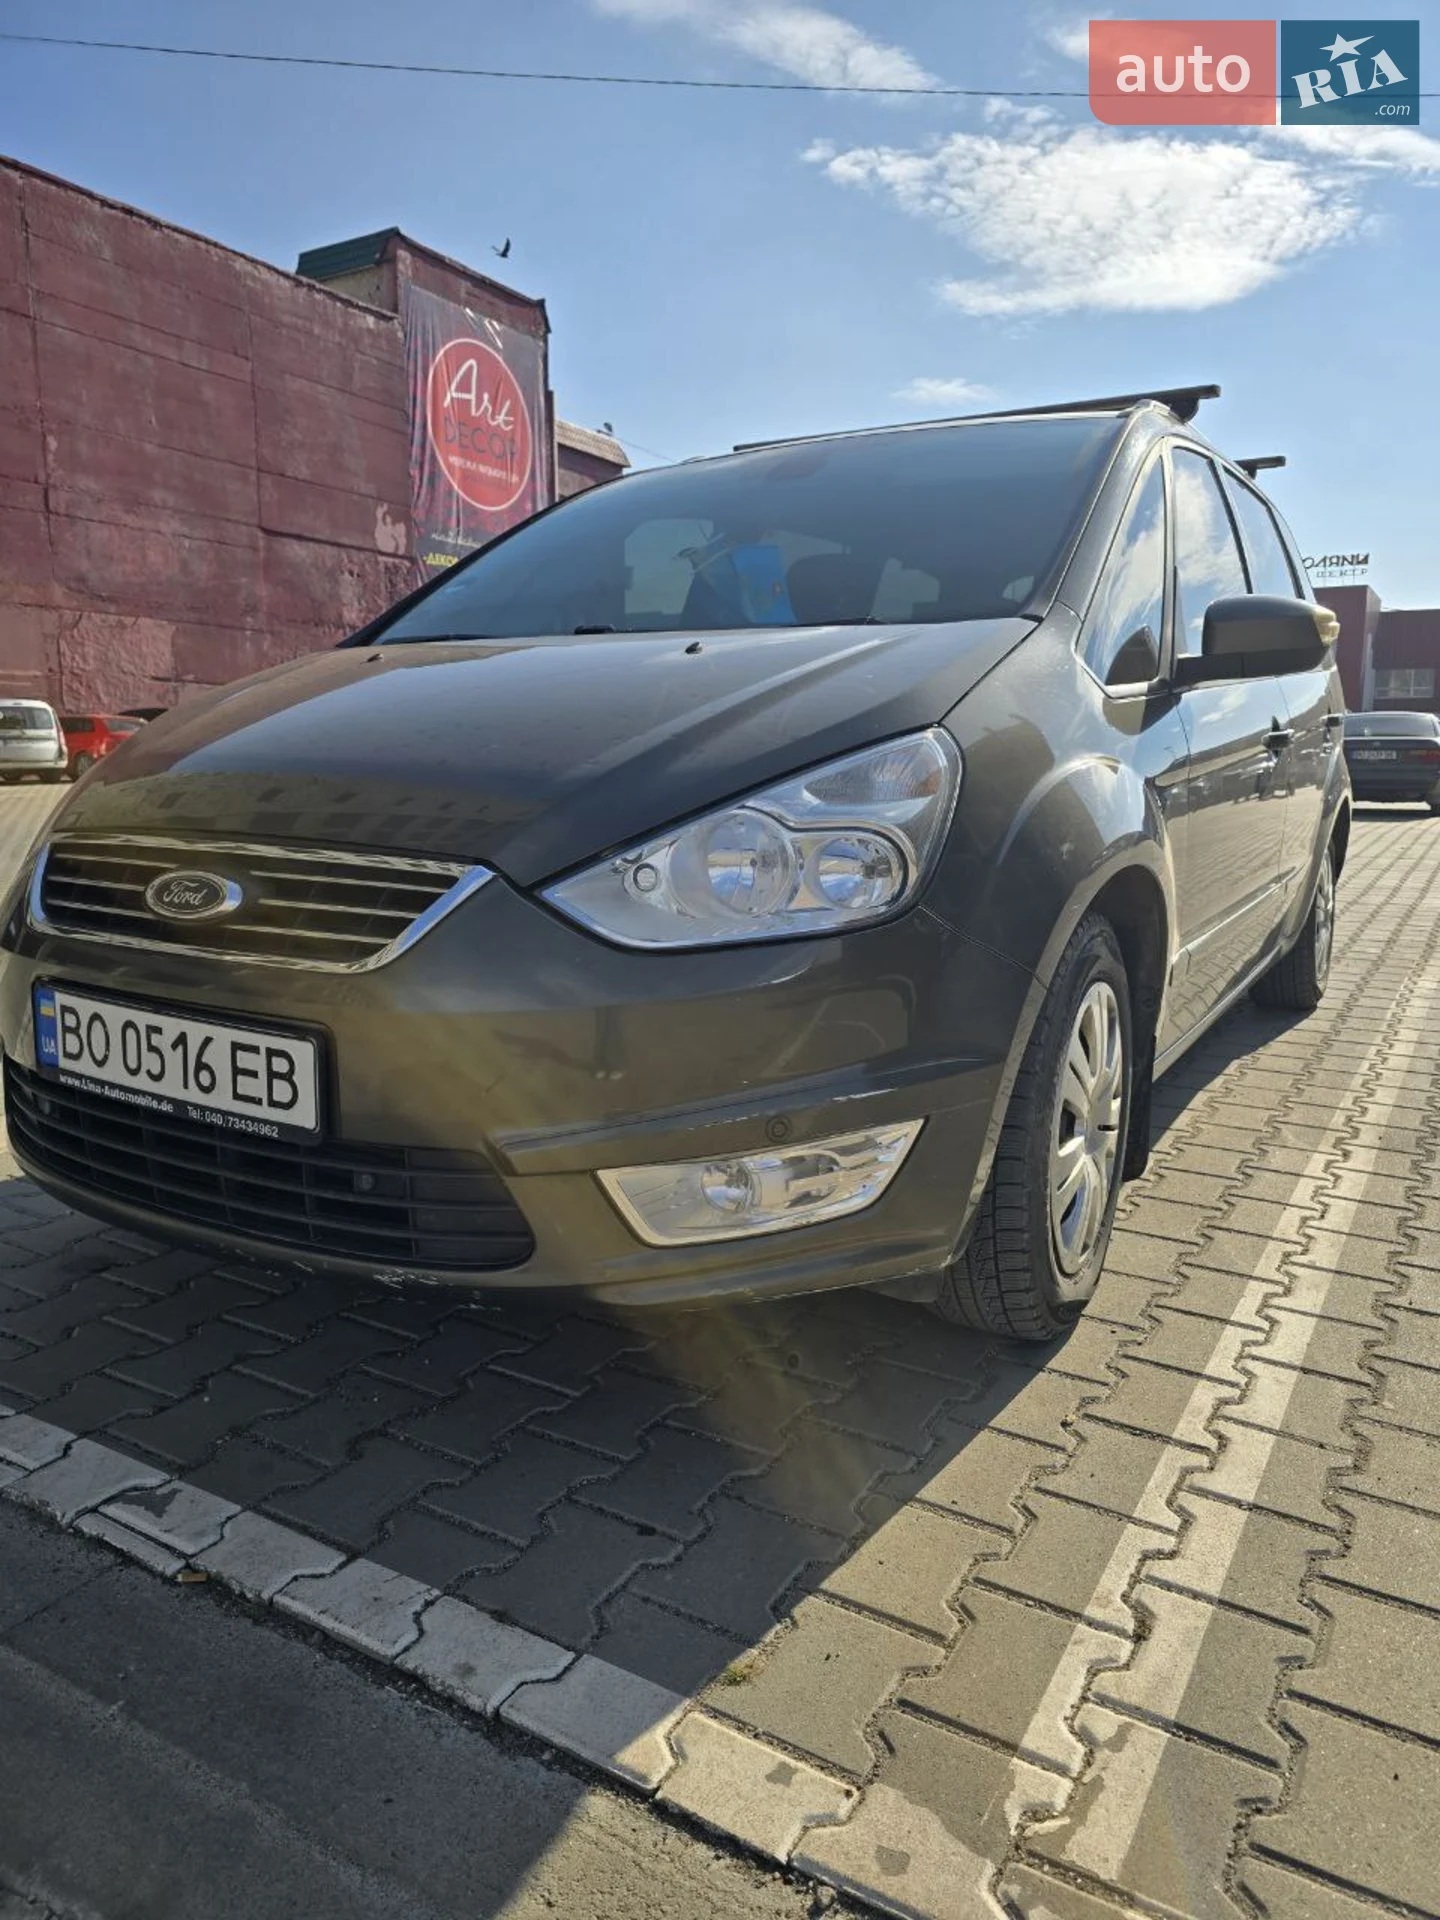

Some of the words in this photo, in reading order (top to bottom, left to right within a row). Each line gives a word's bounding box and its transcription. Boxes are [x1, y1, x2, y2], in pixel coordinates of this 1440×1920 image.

[443, 358, 514, 431] Art
[163, 880, 208, 905] Ford
[41, 1033, 57, 1055] UA
[60, 1004, 110, 1068] BO
[121, 1019, 217, 1094] 0516
[230, 1040, 299, 1111] EB
